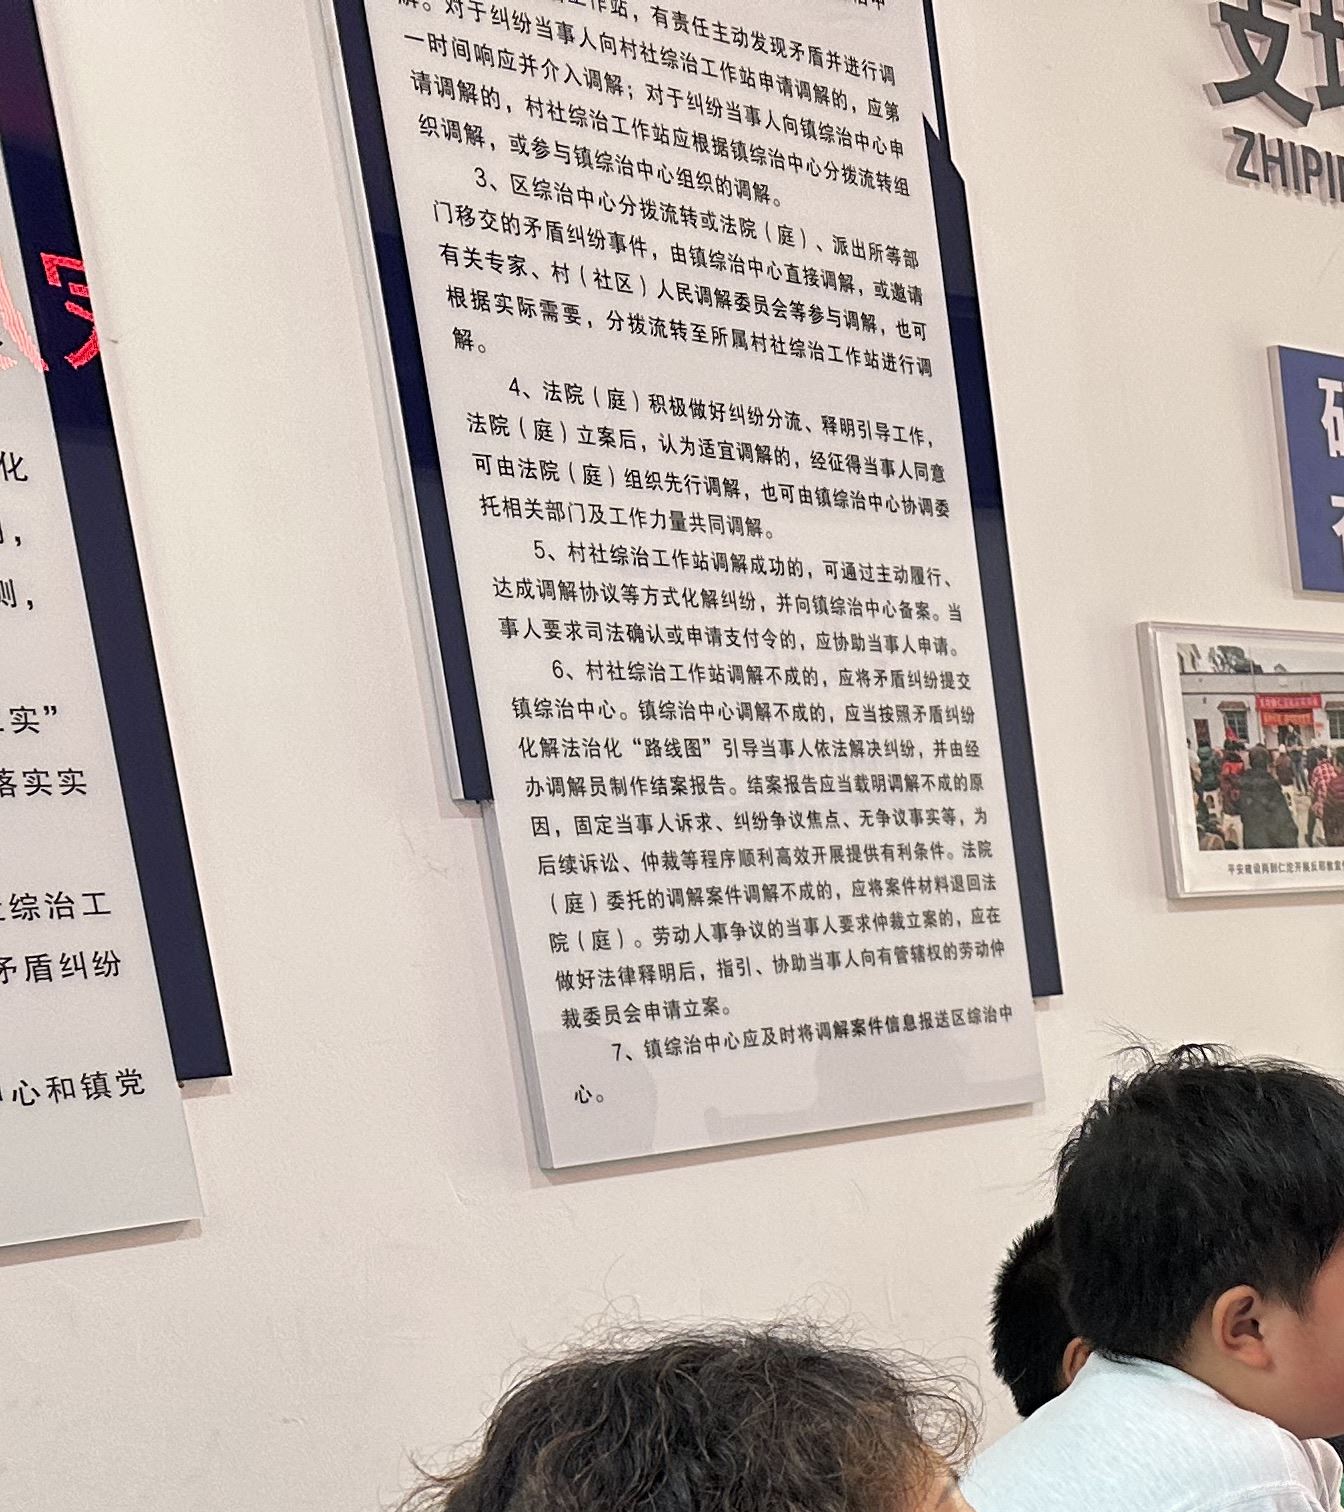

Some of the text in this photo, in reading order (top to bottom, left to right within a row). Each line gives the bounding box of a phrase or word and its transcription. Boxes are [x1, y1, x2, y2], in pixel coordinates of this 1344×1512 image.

[398, 0, 901, 123] 。对于纠纷当事人向村社综治工作站申请调解的，应第
[0, 705, 57, 734] 实”
[0, 890, 112, 922] 综治工
[0, 1067, 146, 1107] 心和镇党
